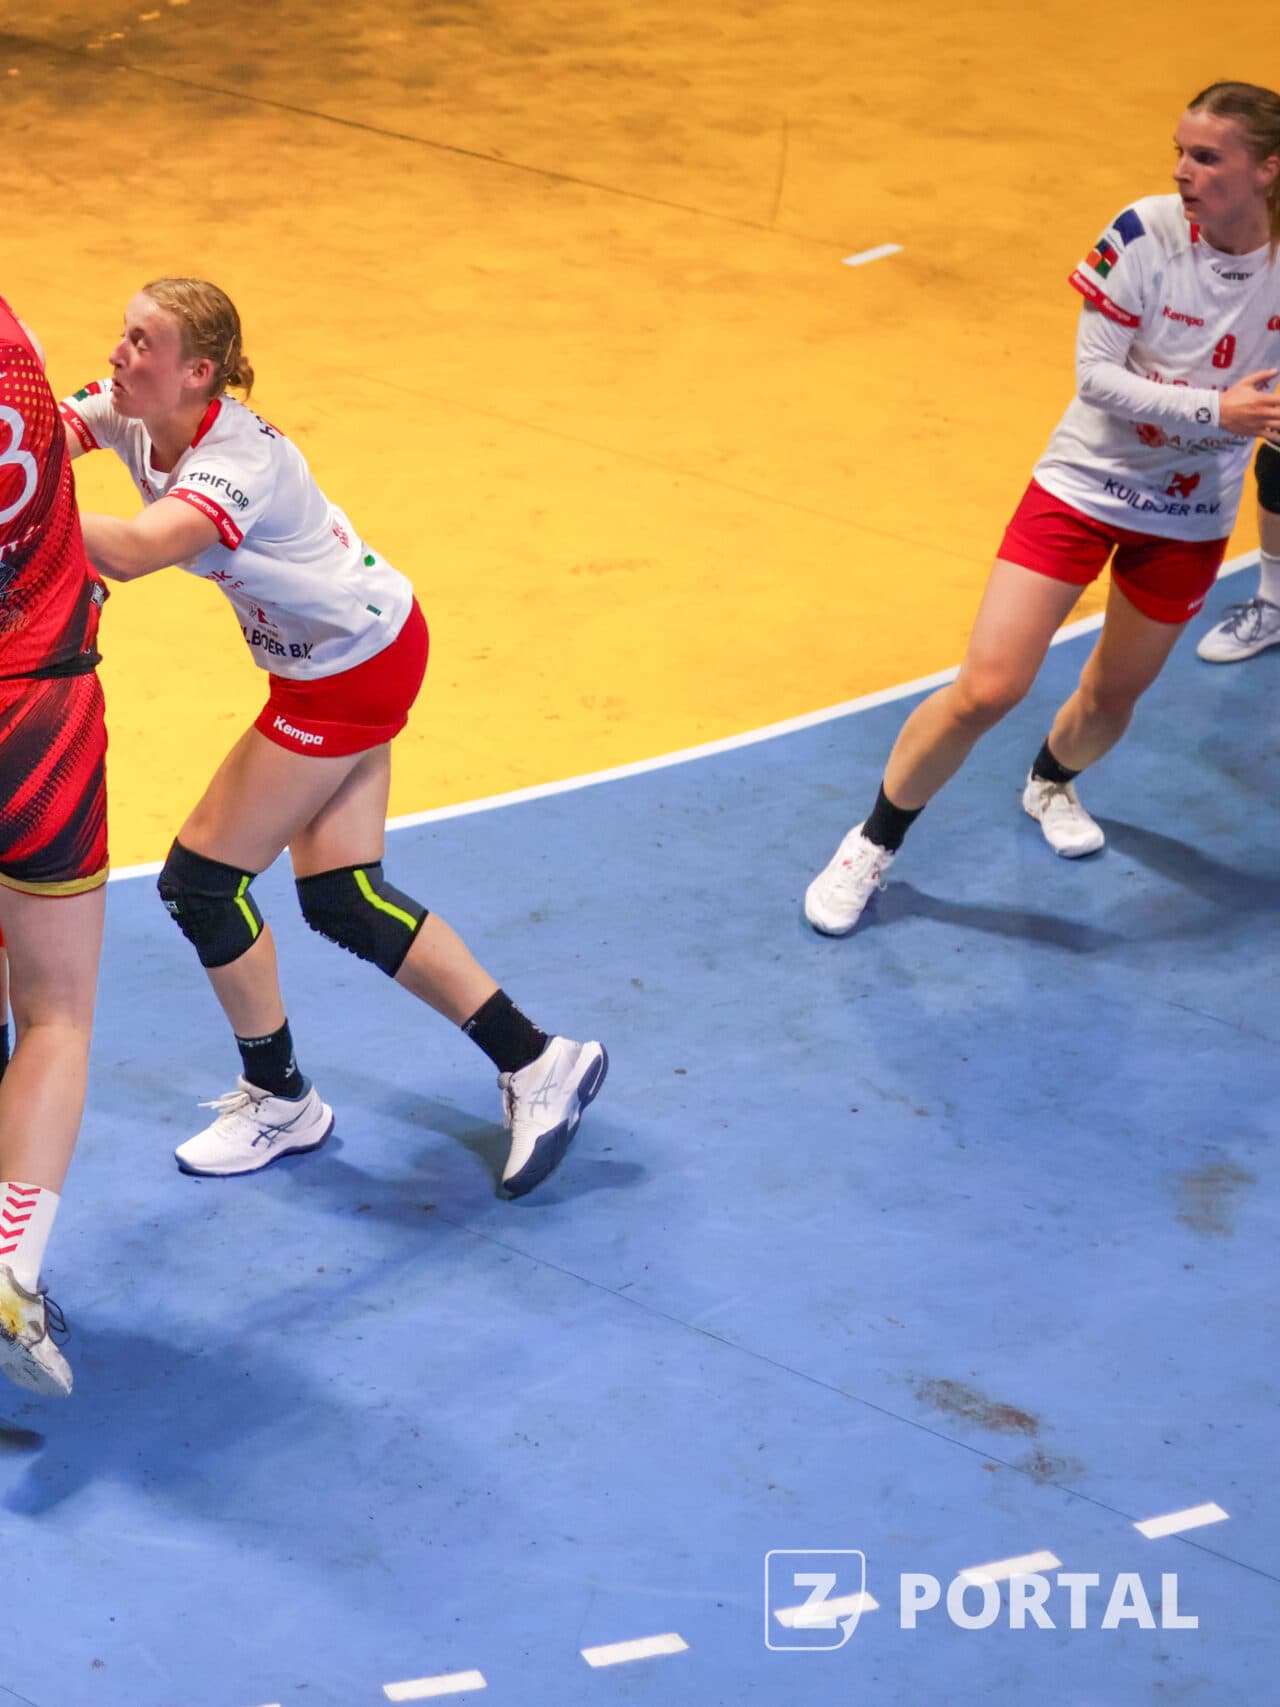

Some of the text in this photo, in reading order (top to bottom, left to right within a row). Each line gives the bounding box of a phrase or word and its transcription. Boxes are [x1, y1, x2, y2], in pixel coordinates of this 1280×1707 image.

[1162, 305, 1205, 327] Kempa
[1212, 333, 1236, 369] 9
[188, 472, 250, 511] TRIFLOR
[273, 715, 324, 745] Kempa
